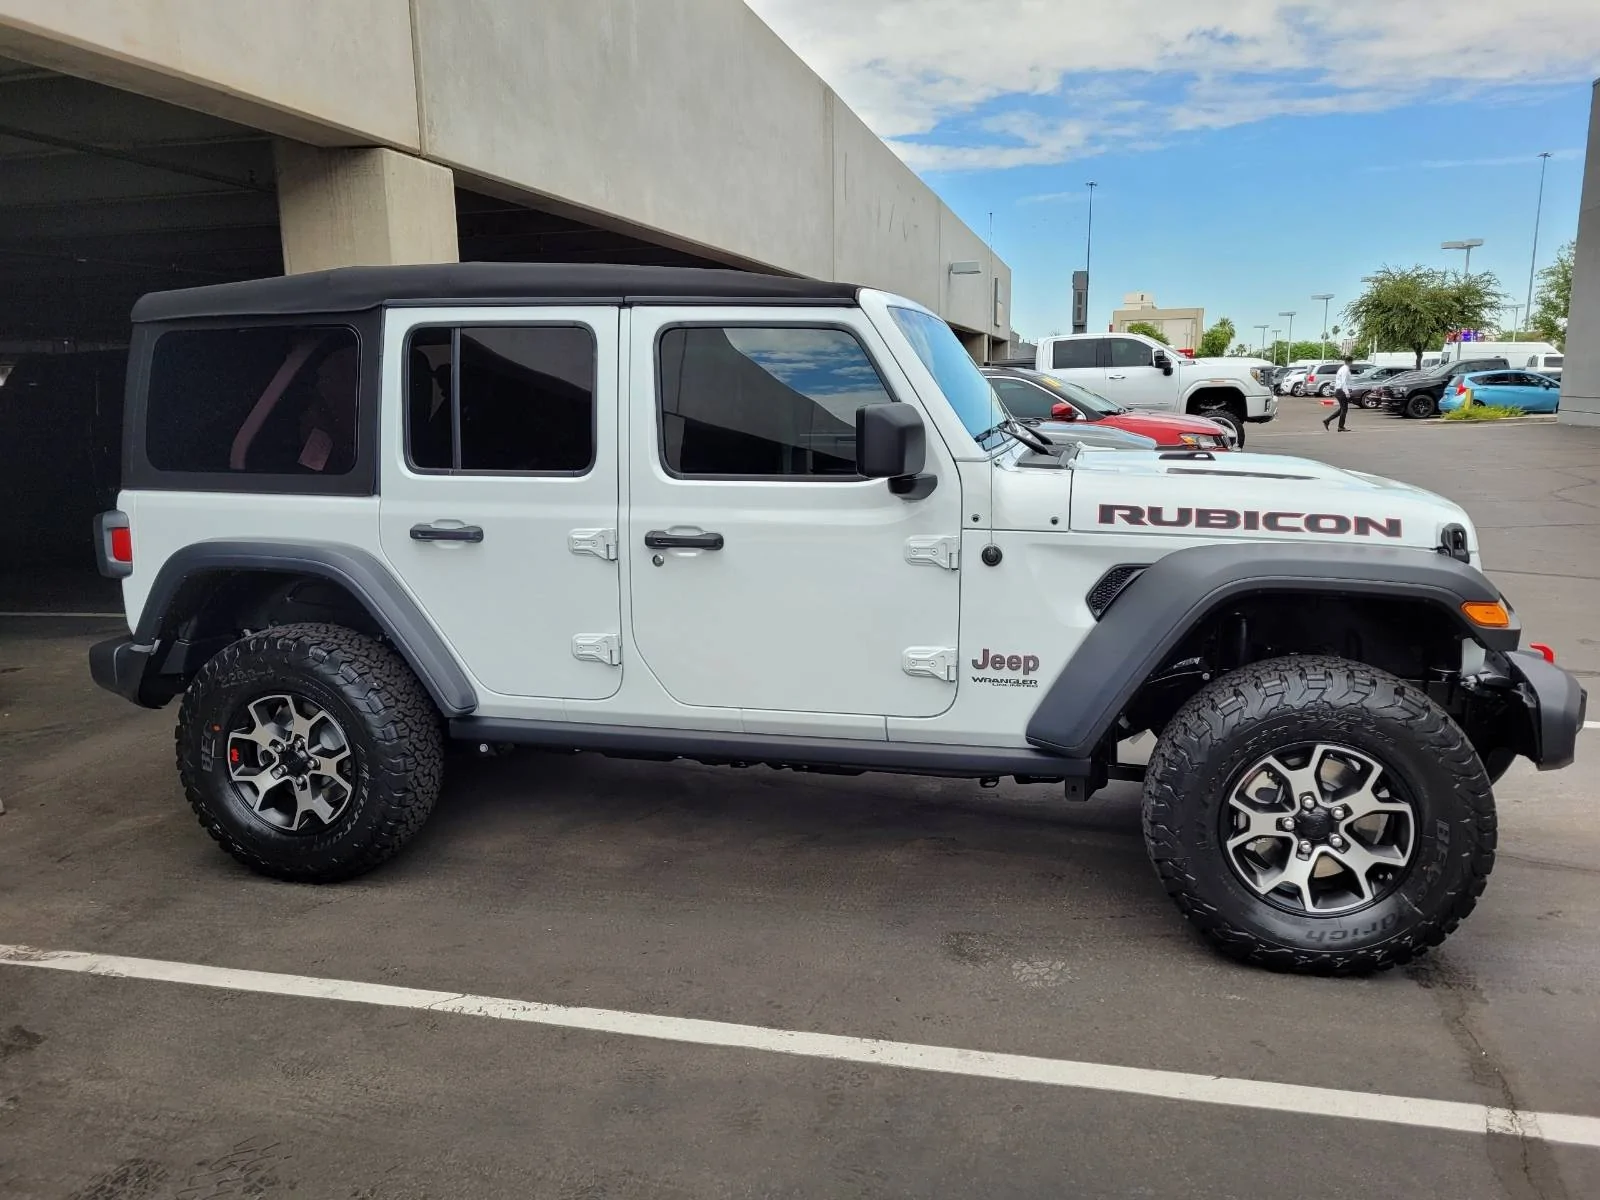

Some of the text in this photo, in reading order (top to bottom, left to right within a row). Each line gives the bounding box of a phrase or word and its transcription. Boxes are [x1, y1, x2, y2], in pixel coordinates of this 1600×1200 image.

[1098, 503, 1403, 538] RUBICON
[971, 648, 1040, 676] Jeep
[971, 676, 1039, 685] WRANGLER
